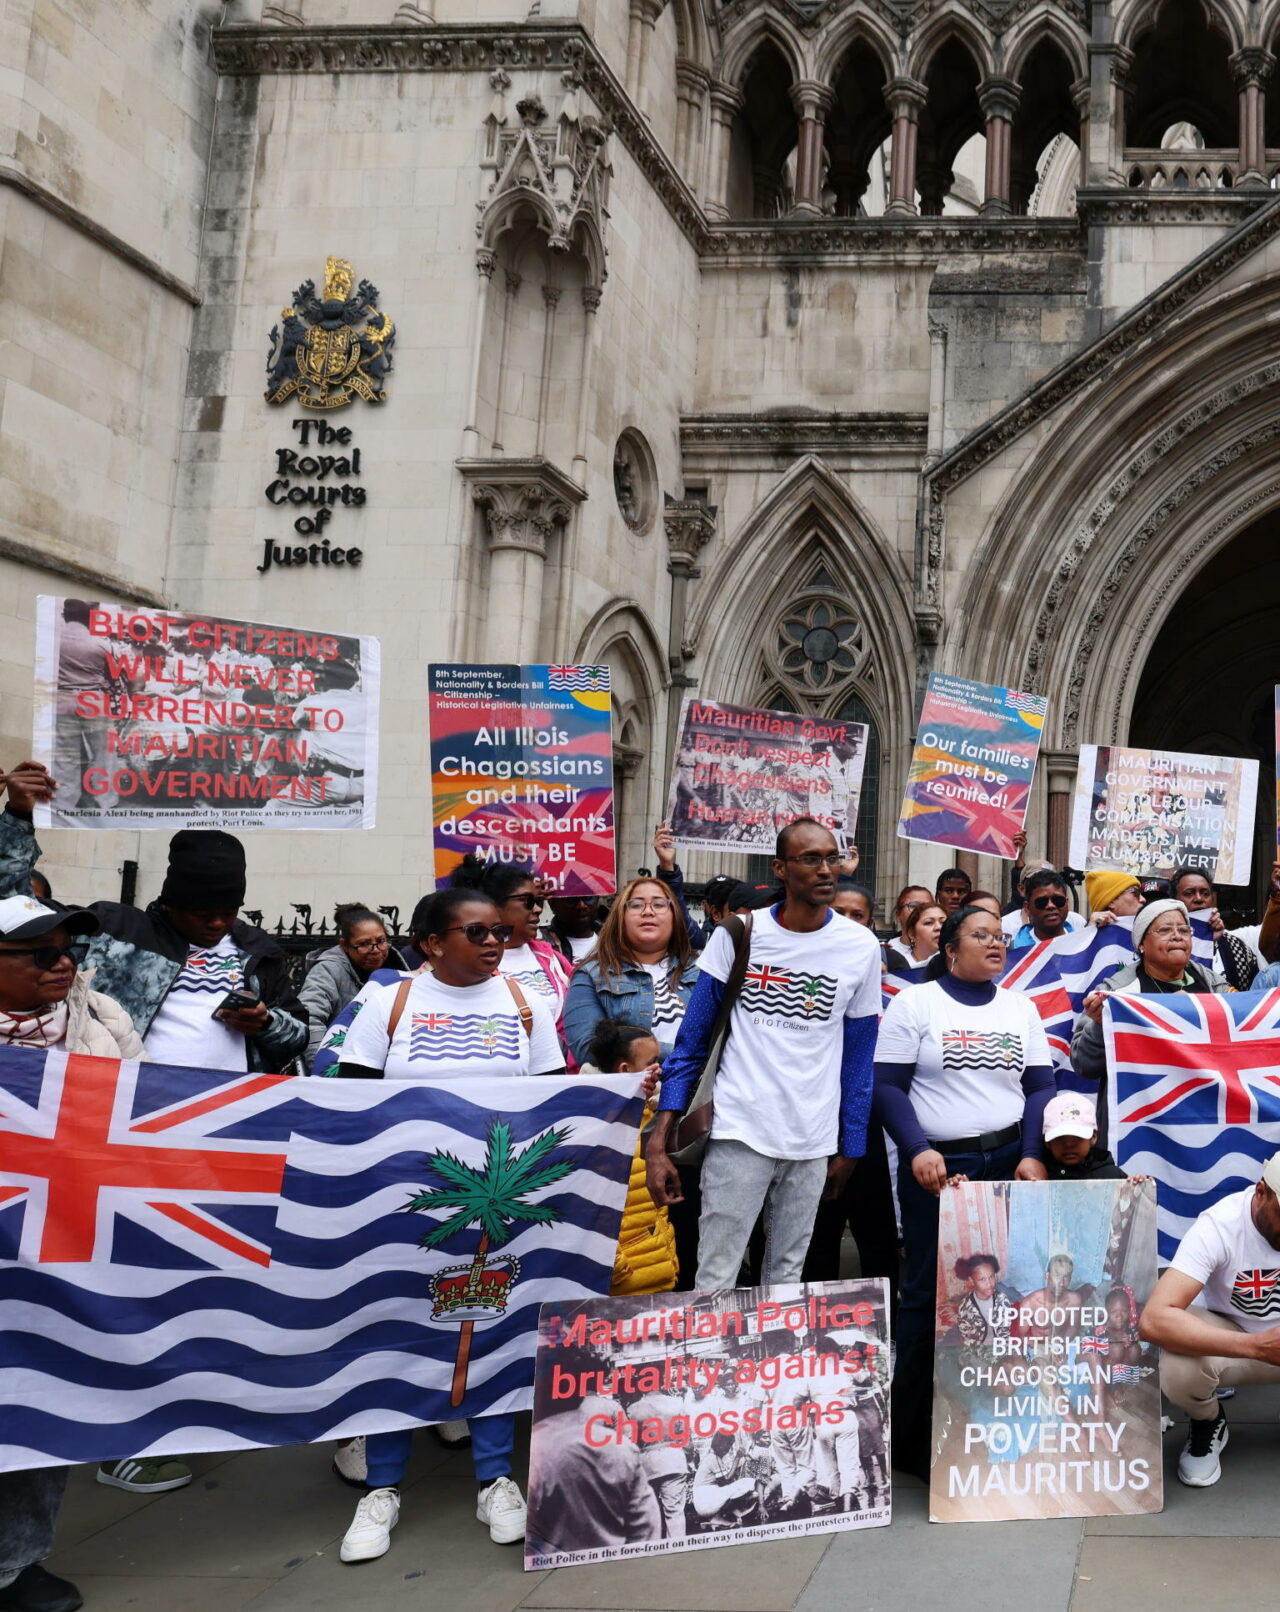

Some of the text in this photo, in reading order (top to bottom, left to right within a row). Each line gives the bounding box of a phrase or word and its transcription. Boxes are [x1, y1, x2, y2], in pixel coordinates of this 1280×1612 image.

[293, 419, 352, 445] The
[276, 448, 360, 480] Royal
[265, 480, 366, 505] Courts
[295, 508, 332, 535] of
[257, 539, 363, 572] Justice
[89, 609, 340, 662] BIOT CITIZENS
[107, 653, 316, 694] WILL NEVER
[436, 681, 484, 690] Nationality
[452, 671, 504, 679] September,
[444, 691, 492, 699] Citizenship
[481, 702, 527, 710] Legislative
[75, 692, 344, 732] SURRENDER TO
[690, 703, 847, 743] Mauritian Govt
[107, 728, 308, 763] MAURITIAN
[474, 727, 569, 746] All Illois
[695, 733, 832, 768] Don't respect
[922, 733, 1029, 769] Our families
[440, 756, 603, 779] Chagossians
[935, 760, 1008, 785] must be
[1119, 756, 1216, 775] MAURITIAN
[83, 767, 332, 800] GOVERNMENT
[694, 763, 832, 794] Chagossians
[1106, 772, 1228, 794] GOVERNMENT
[466, 784, 580, 804] and their
[926, 781, 1008, 808] reunited!
[1118, 793, 1212, 810] STOLE OUR
[440, 814, 606, 835] descendants
[688, 801, 769, 825] Human
[1094, 809, 1235, 832] COMPENSATION
[1092, 827, 1234, 851] MADE US LIVE IN
[475, 843, 576, 864] MUST BE
[783, 1022, 808, 1031] Citizen
[548, 1307, 742, 1348] Mauritian
[757, 1296, 874, 1332] Police
[988, 1306, 1108, 1328] UPROOTED
[993, 1336, 1081, 1356] BRITISH
[552, 1344, 878, 1400] brutality against
[960, 1364, 1112, 1387] CHAGOSSIAN
[994, 1395, 1099, 1418] LIVING IN
[584, 1399, 845, 1448] Chagossians
[964, 1422, 1127, 1454] POVERTY
[949, 1459, 1150, 1498] MAURITIUS
[532, 1555, 552, 1567] Riot
[556, 1552, 585, 1564] Police
[589, 1551, 598, 1560] in
[602, 1549, 617, 1558] the
[620, 1542, 669, 1556] fore-front
[687, 1537, 710, 1546] their
[713, 1535, 732, 1543] way
[735, 1531, 743, 1539] to
[747, 1526, 785, 1538] disperse
[788, 1523, 803, 1531] the
[806, 1517, 850, 1532] protesters
[854, 1511, 882, 1523] during
